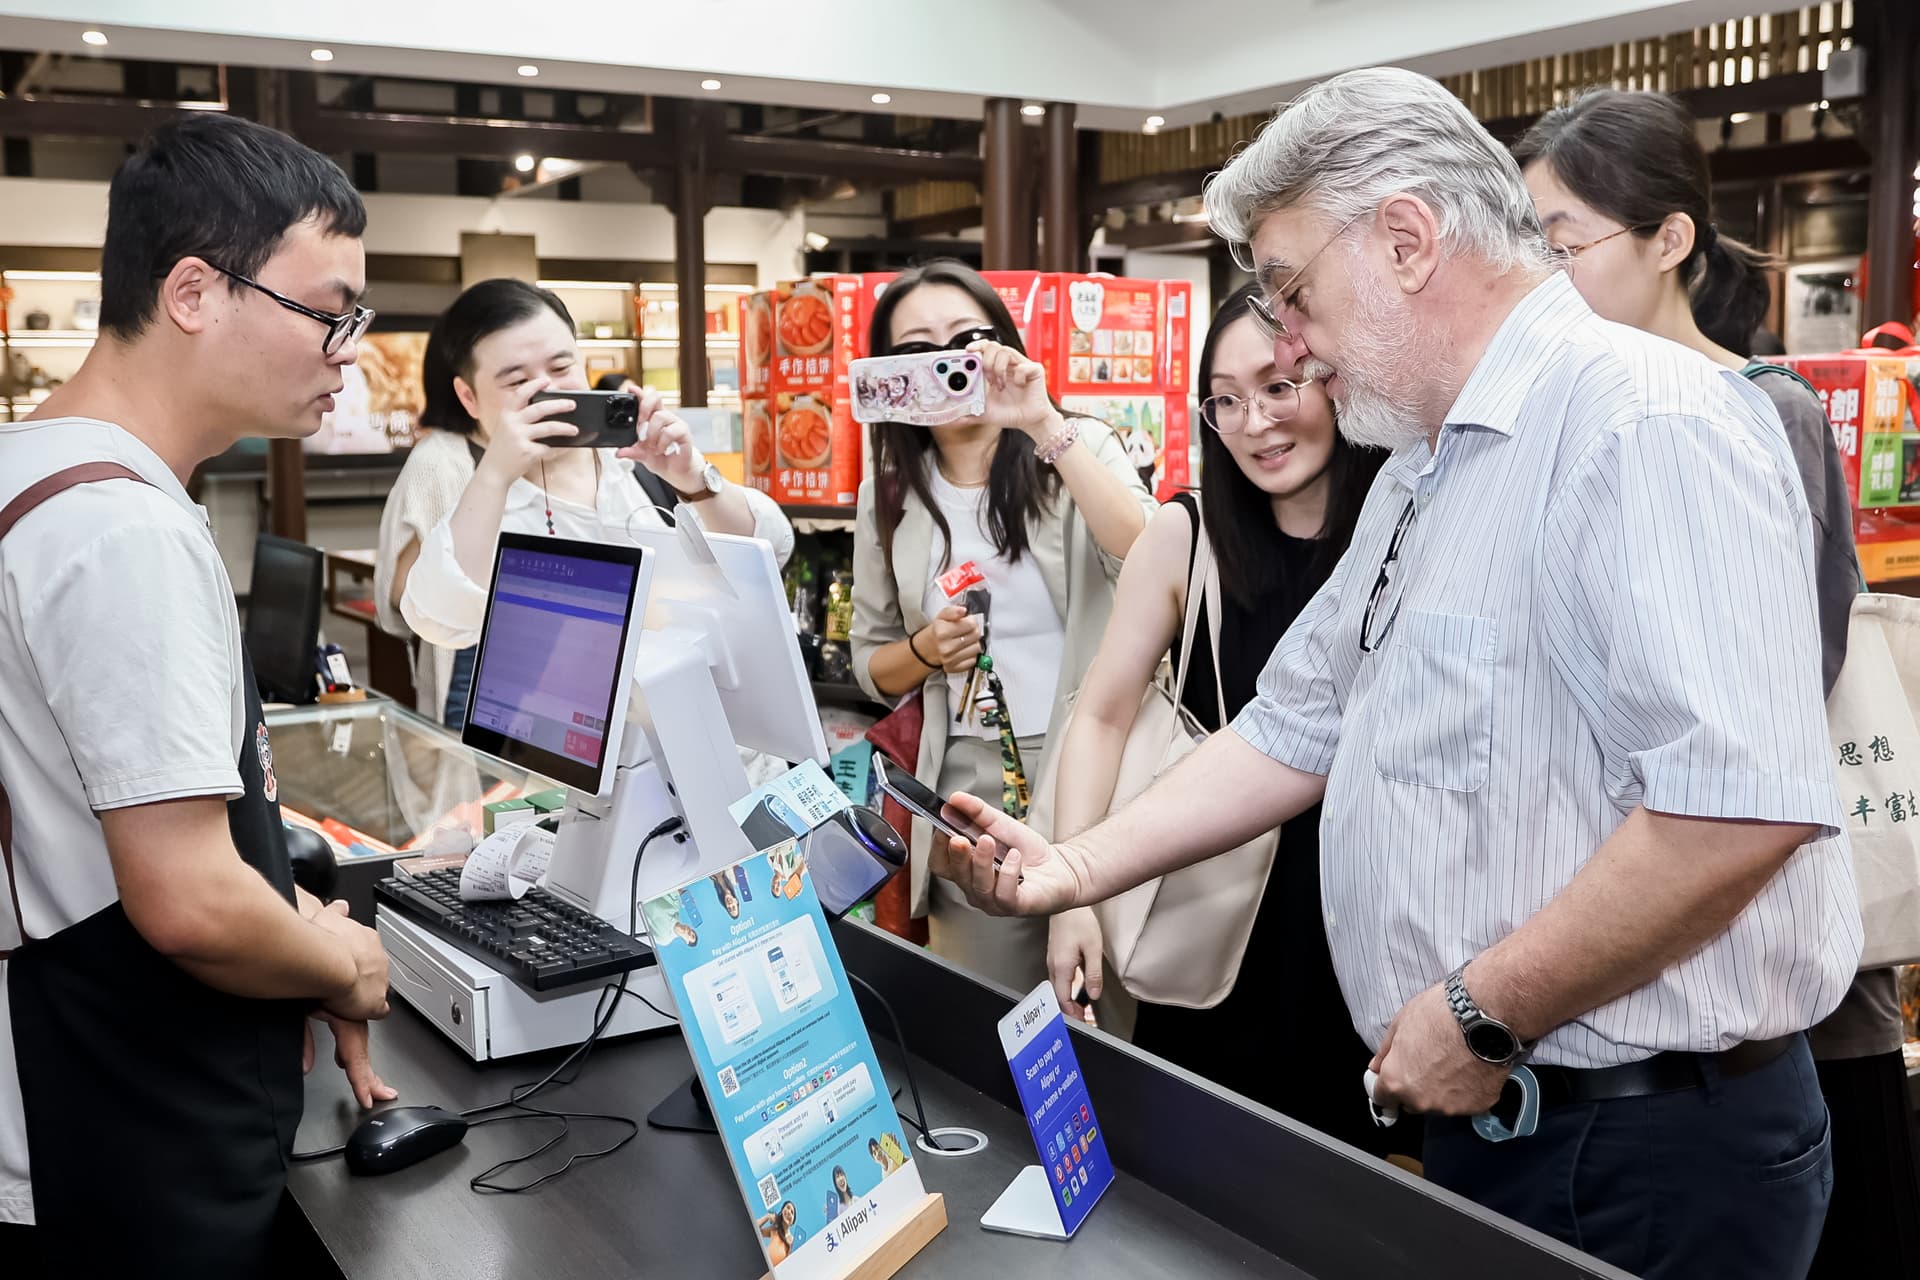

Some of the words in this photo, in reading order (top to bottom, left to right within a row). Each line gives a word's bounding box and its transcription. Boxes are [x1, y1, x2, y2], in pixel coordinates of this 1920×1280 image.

[730, 916, 755, 936] Option1
[783, 1057, 807, 1080] Option2
[1025, 1063, 1039, 1080] Scan
[1037, 1058, 1044, 1069] to
[1043, 1048, 1053, 1066] pay
[1052, 1037, 1063, 1054] with
[1040, 1070, 1055, 1091] Alipay
[1054, 1064, 1060, 1076] or
[1034, 1103, 1046, 1125] your
[1043, 1091, 1059, 1111] home
[1058, 1070, 1078, 1096] e-wallets
